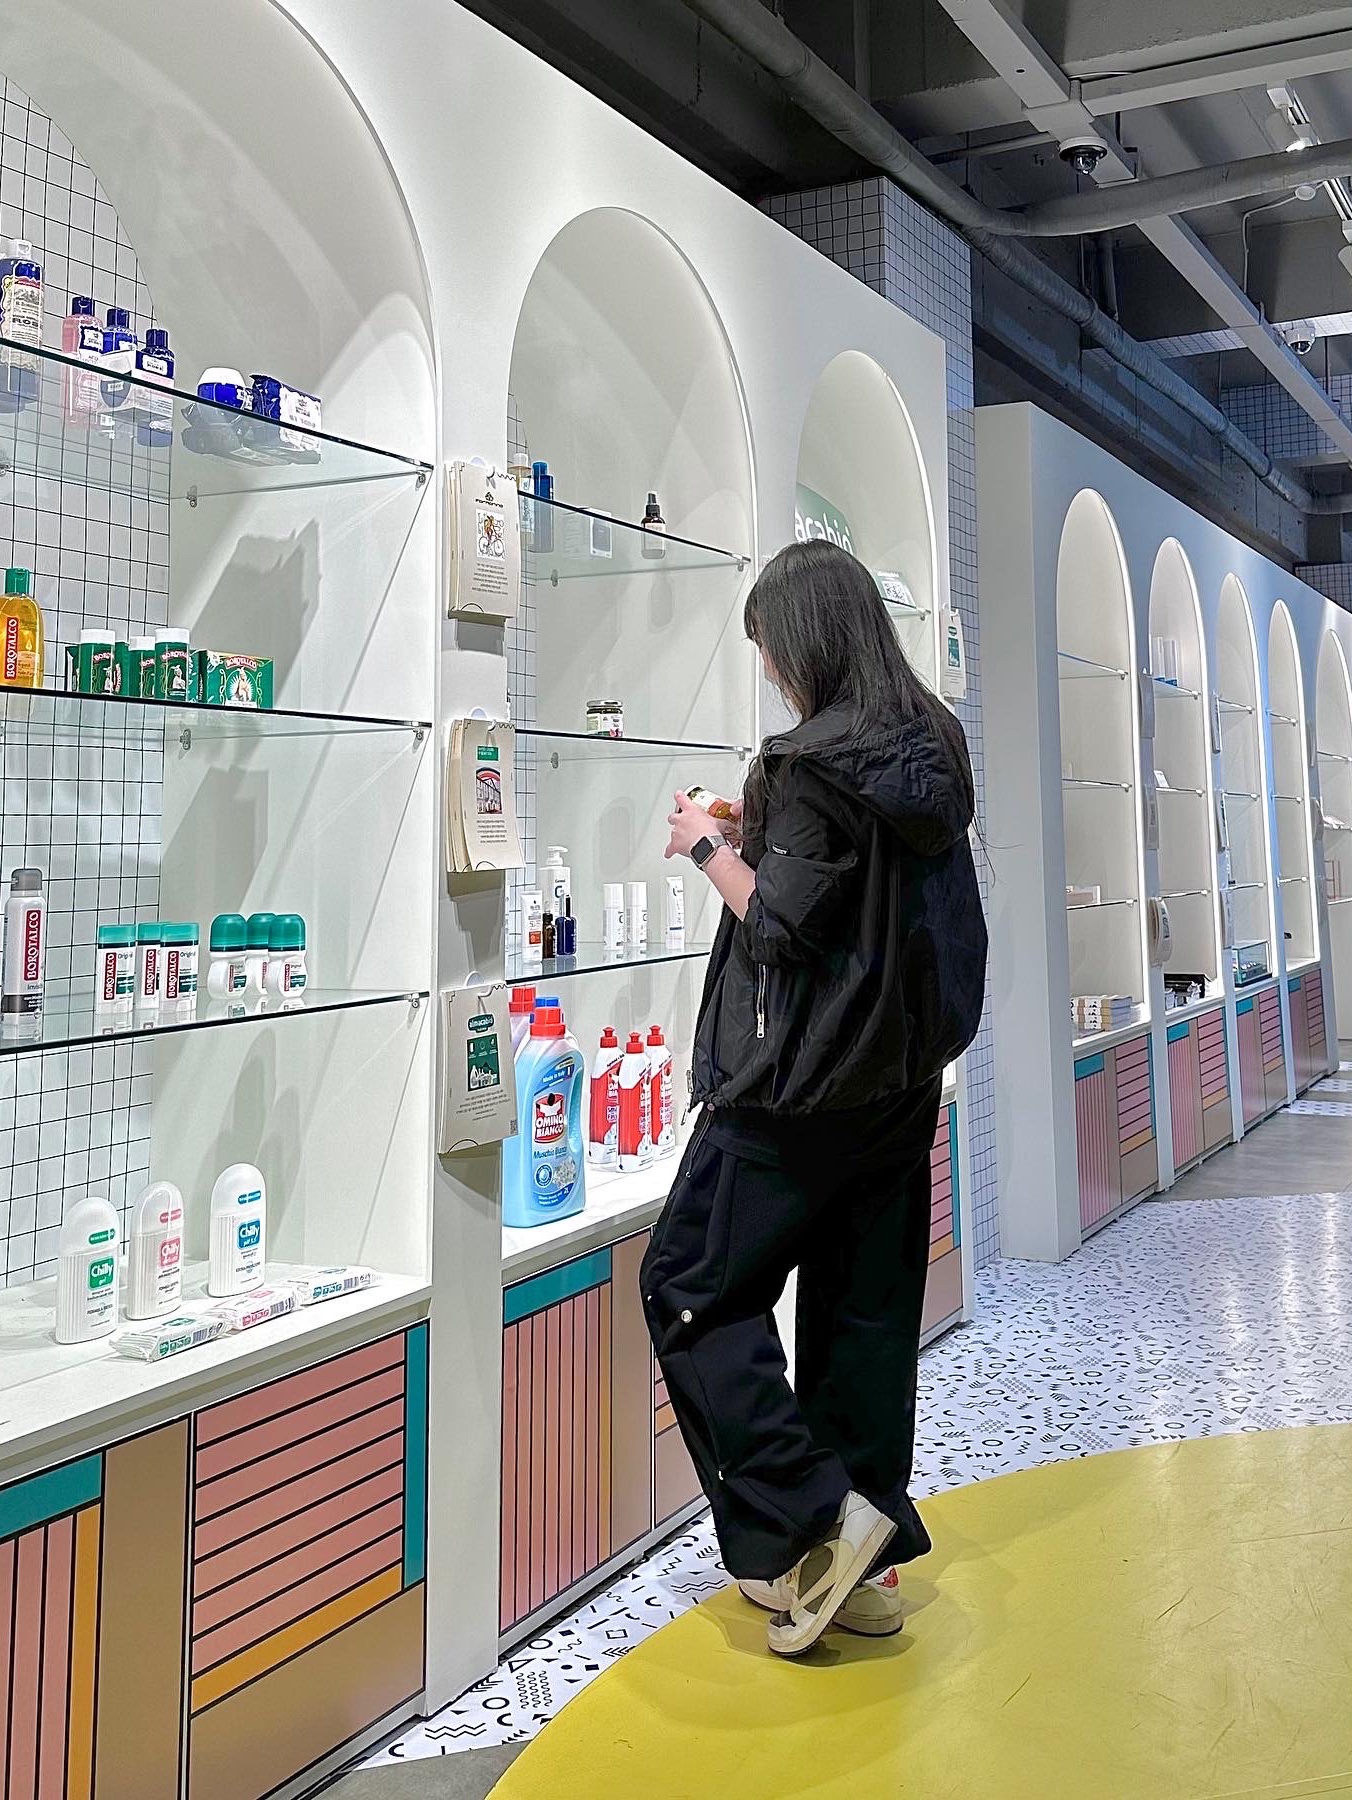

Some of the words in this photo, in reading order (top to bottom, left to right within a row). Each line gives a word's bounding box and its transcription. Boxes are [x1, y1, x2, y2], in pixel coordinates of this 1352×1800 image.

[6, 618, 18, 678] BOROTALCO
[27, 911, 39, 979] BOROTALCO
[105, 953, 115, 999] BOROTALCO
[146, 950, 155, 994] BOROTALCO
[168, 951, 178, 997] BOROTALCO
[536, 1113, 564, 1129] OMINO
[536, 1124, 564, 1138] BIANCO
[239, 1223, 260, 1239] Chilly
[161, 1241, 180, 1257] Chilly
[91, 1262, 114, 1278] Chilly
